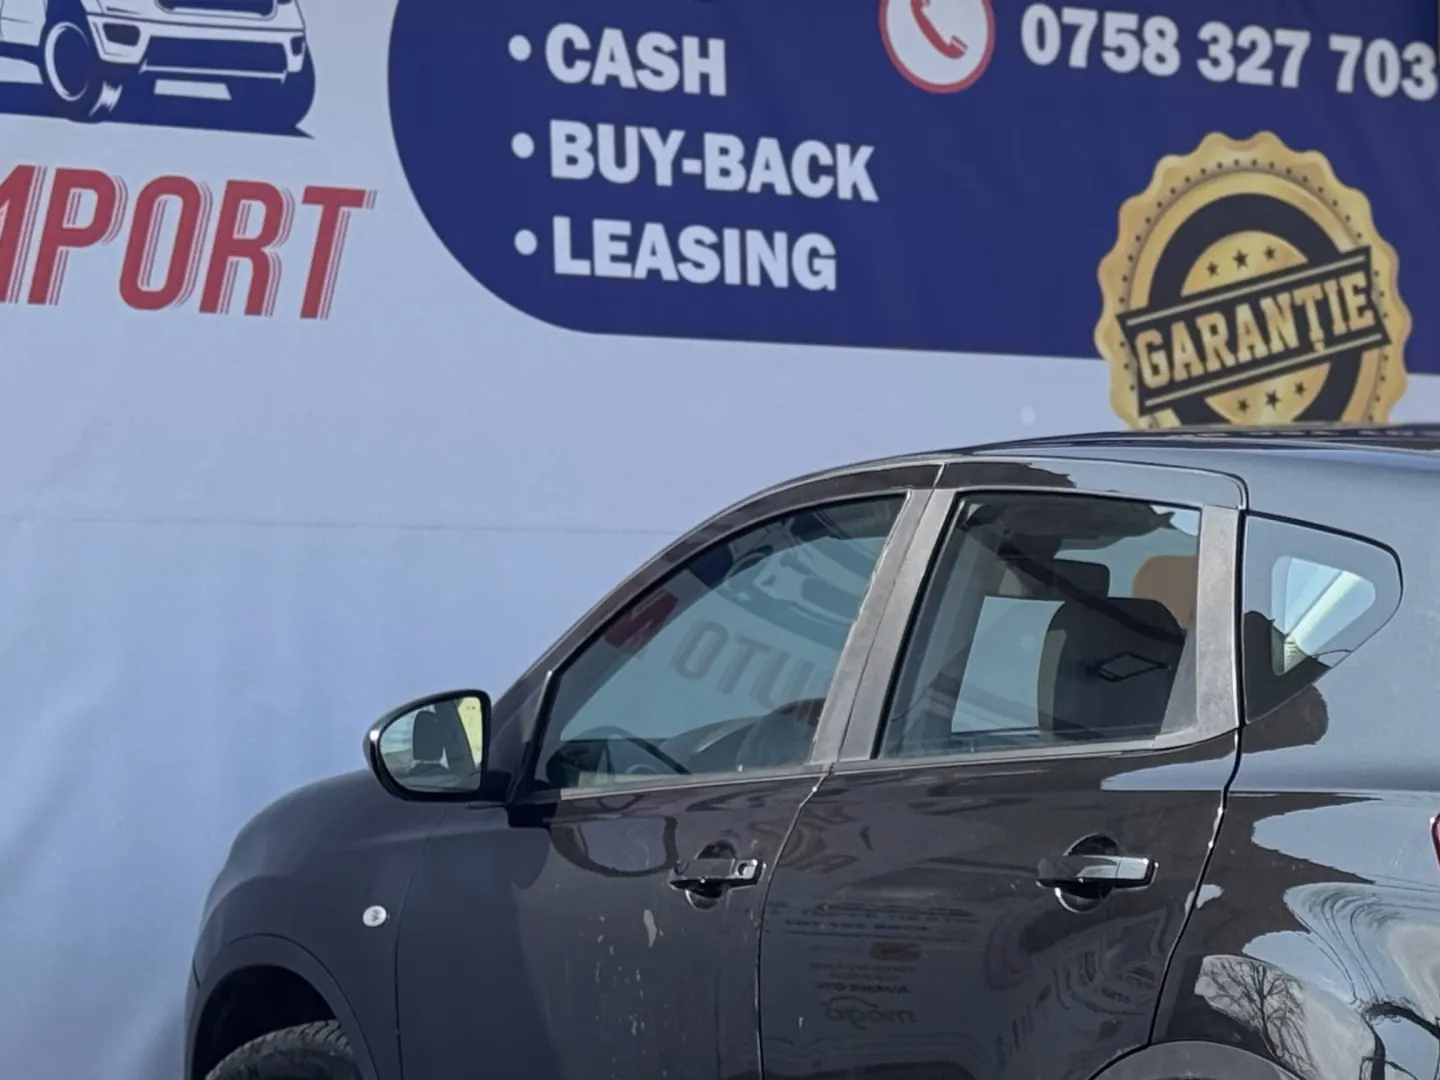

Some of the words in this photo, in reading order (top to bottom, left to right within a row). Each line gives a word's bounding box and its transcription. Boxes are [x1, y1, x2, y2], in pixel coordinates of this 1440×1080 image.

[545, 22, 726, 97] CASH
[1020, 2, 1181, 77] 0758
[1196, 21, 1311, 89] 327
[1328, 33, 1439, 101] 703
[549, 118, 880, 203] BUY-BACK
[552, 214, 837, 291] LEASING
